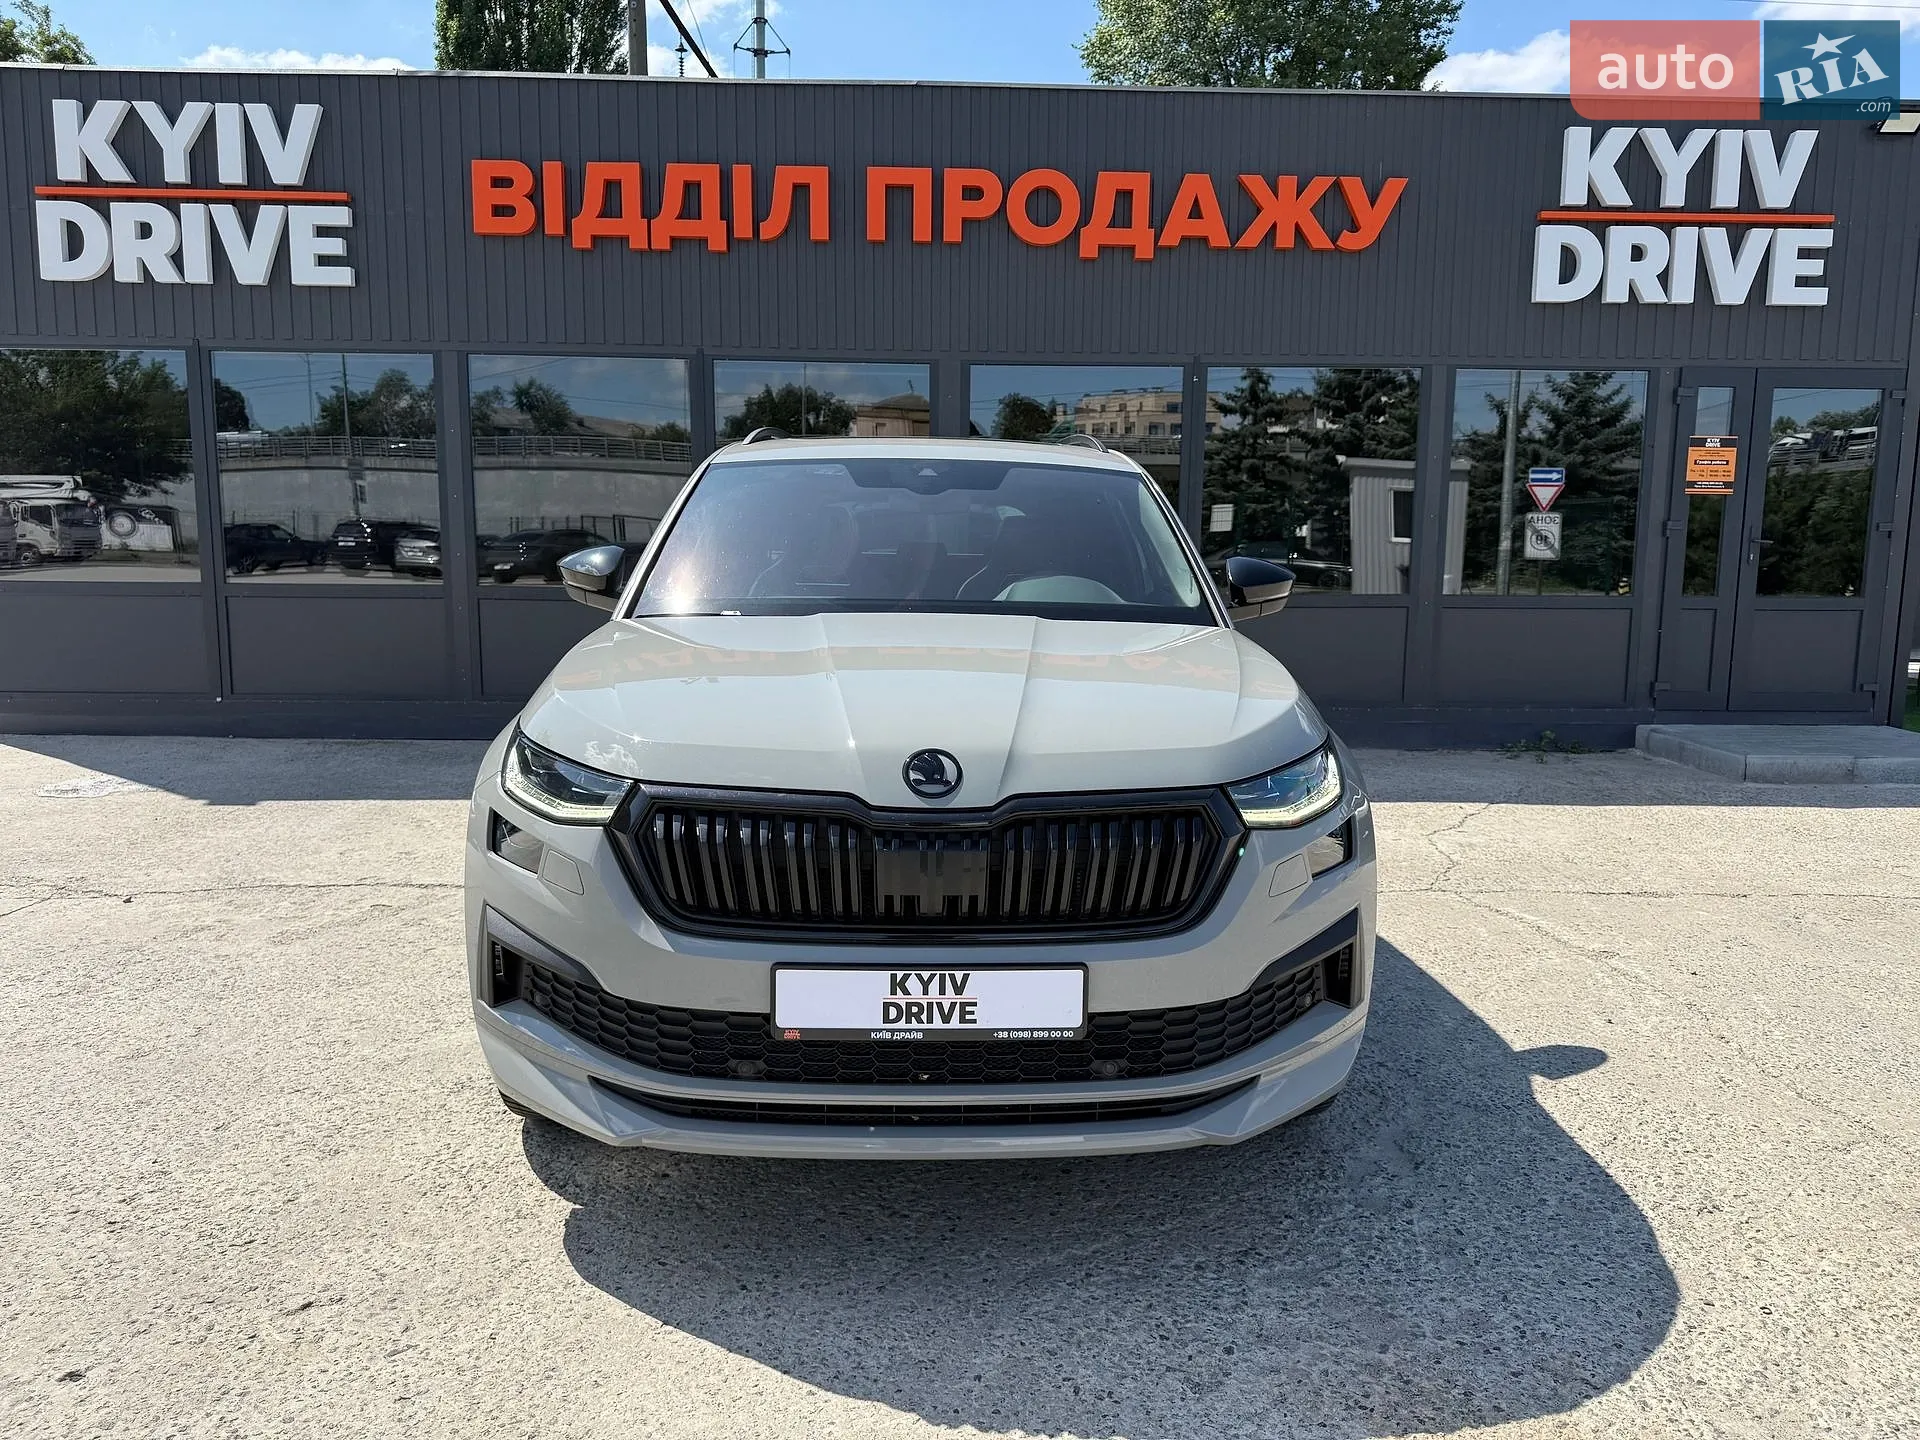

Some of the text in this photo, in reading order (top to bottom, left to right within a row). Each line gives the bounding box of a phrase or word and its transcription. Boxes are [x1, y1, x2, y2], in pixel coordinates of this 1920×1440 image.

[52, 99, 323, 186] KYIV
[1559, 126, 1820, 210] KYIV
[35, 200, 356, 288] DRIVE
[471, 159, 1409, 260] ВІДДІЛ ПРОДАЖУ
[1531, 224, 1834, 306] DRIVE
[882, 1001, 978, 1025] DRIVE
[889, 972, 971, 996] KYIV
[870, 1030, 923, 1040] КИЇВ ДРАЙВ
[1010, 1030, 1032, 1038] (098)
